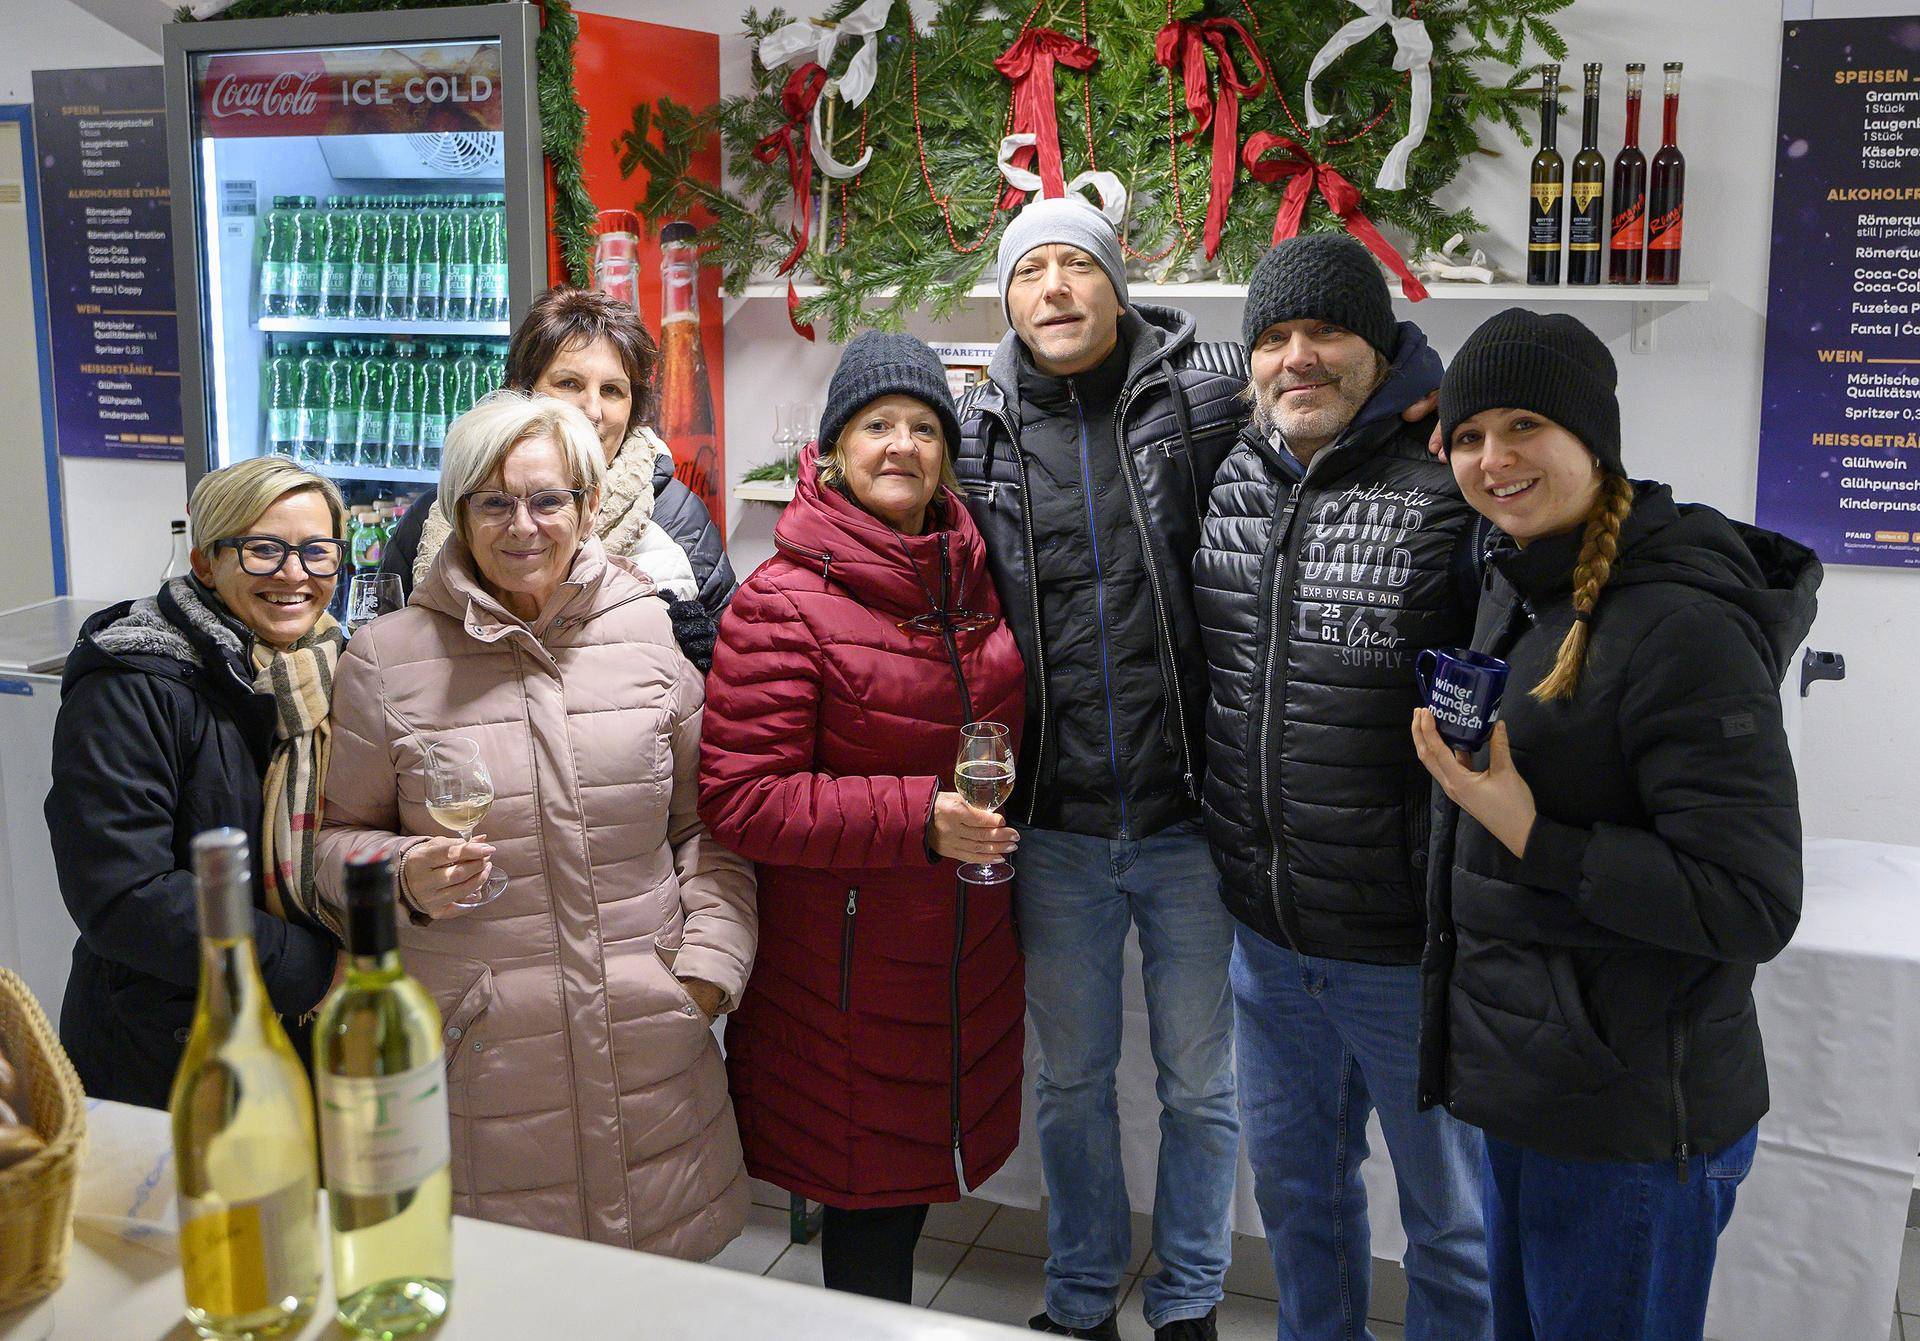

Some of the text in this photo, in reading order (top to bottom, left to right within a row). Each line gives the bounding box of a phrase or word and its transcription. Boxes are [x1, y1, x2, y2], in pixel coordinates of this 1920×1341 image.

[1835, 69, 1908, 84] SPEISEN
[342, 75, 493, 106] ICE COLD
[1865, 104, 1905, 113] 1 Stück
[1863, 132, 1903, 141] 1 Stück
[1862, 145, 1920, 157] Käsebre
[1862, 159, 1901, 169] 1 Stück
[1857, 227, 1877, 237] still
[76, 304, 101, 314] WEIN
[1852, 302, 1908, 314] Fuzetea
[1851, 323, 1891, 334] Fanta
[1818, 350, 1863, 363] WEIN
[1845, 407, 1900, 420] Spritzer
[1812, 432, 1920, 448] HEISSGETRÄ
[1842, 457, 1907, 470] Glühwein
[1338, 482, 1433, 507] Authentic
[1315, 502, 1422, 542] CAMP
[1845, 532, 1871, 540] PFAND
[1304, 543, 1412, 586] DAVID
[1303, 586, 1323, 598] EXP.
[1326, 589, 1339, 599] BY
[1342, 590, 1364, 602] SEA
[1379, 594, 1400, 605] AIR
[1321, 603, 1341, 618] 25
[1321, 625, 1341, 642] 01
[1435, 677, 1472, 700] winter
[1431, 690, 1478, 716] wunder
